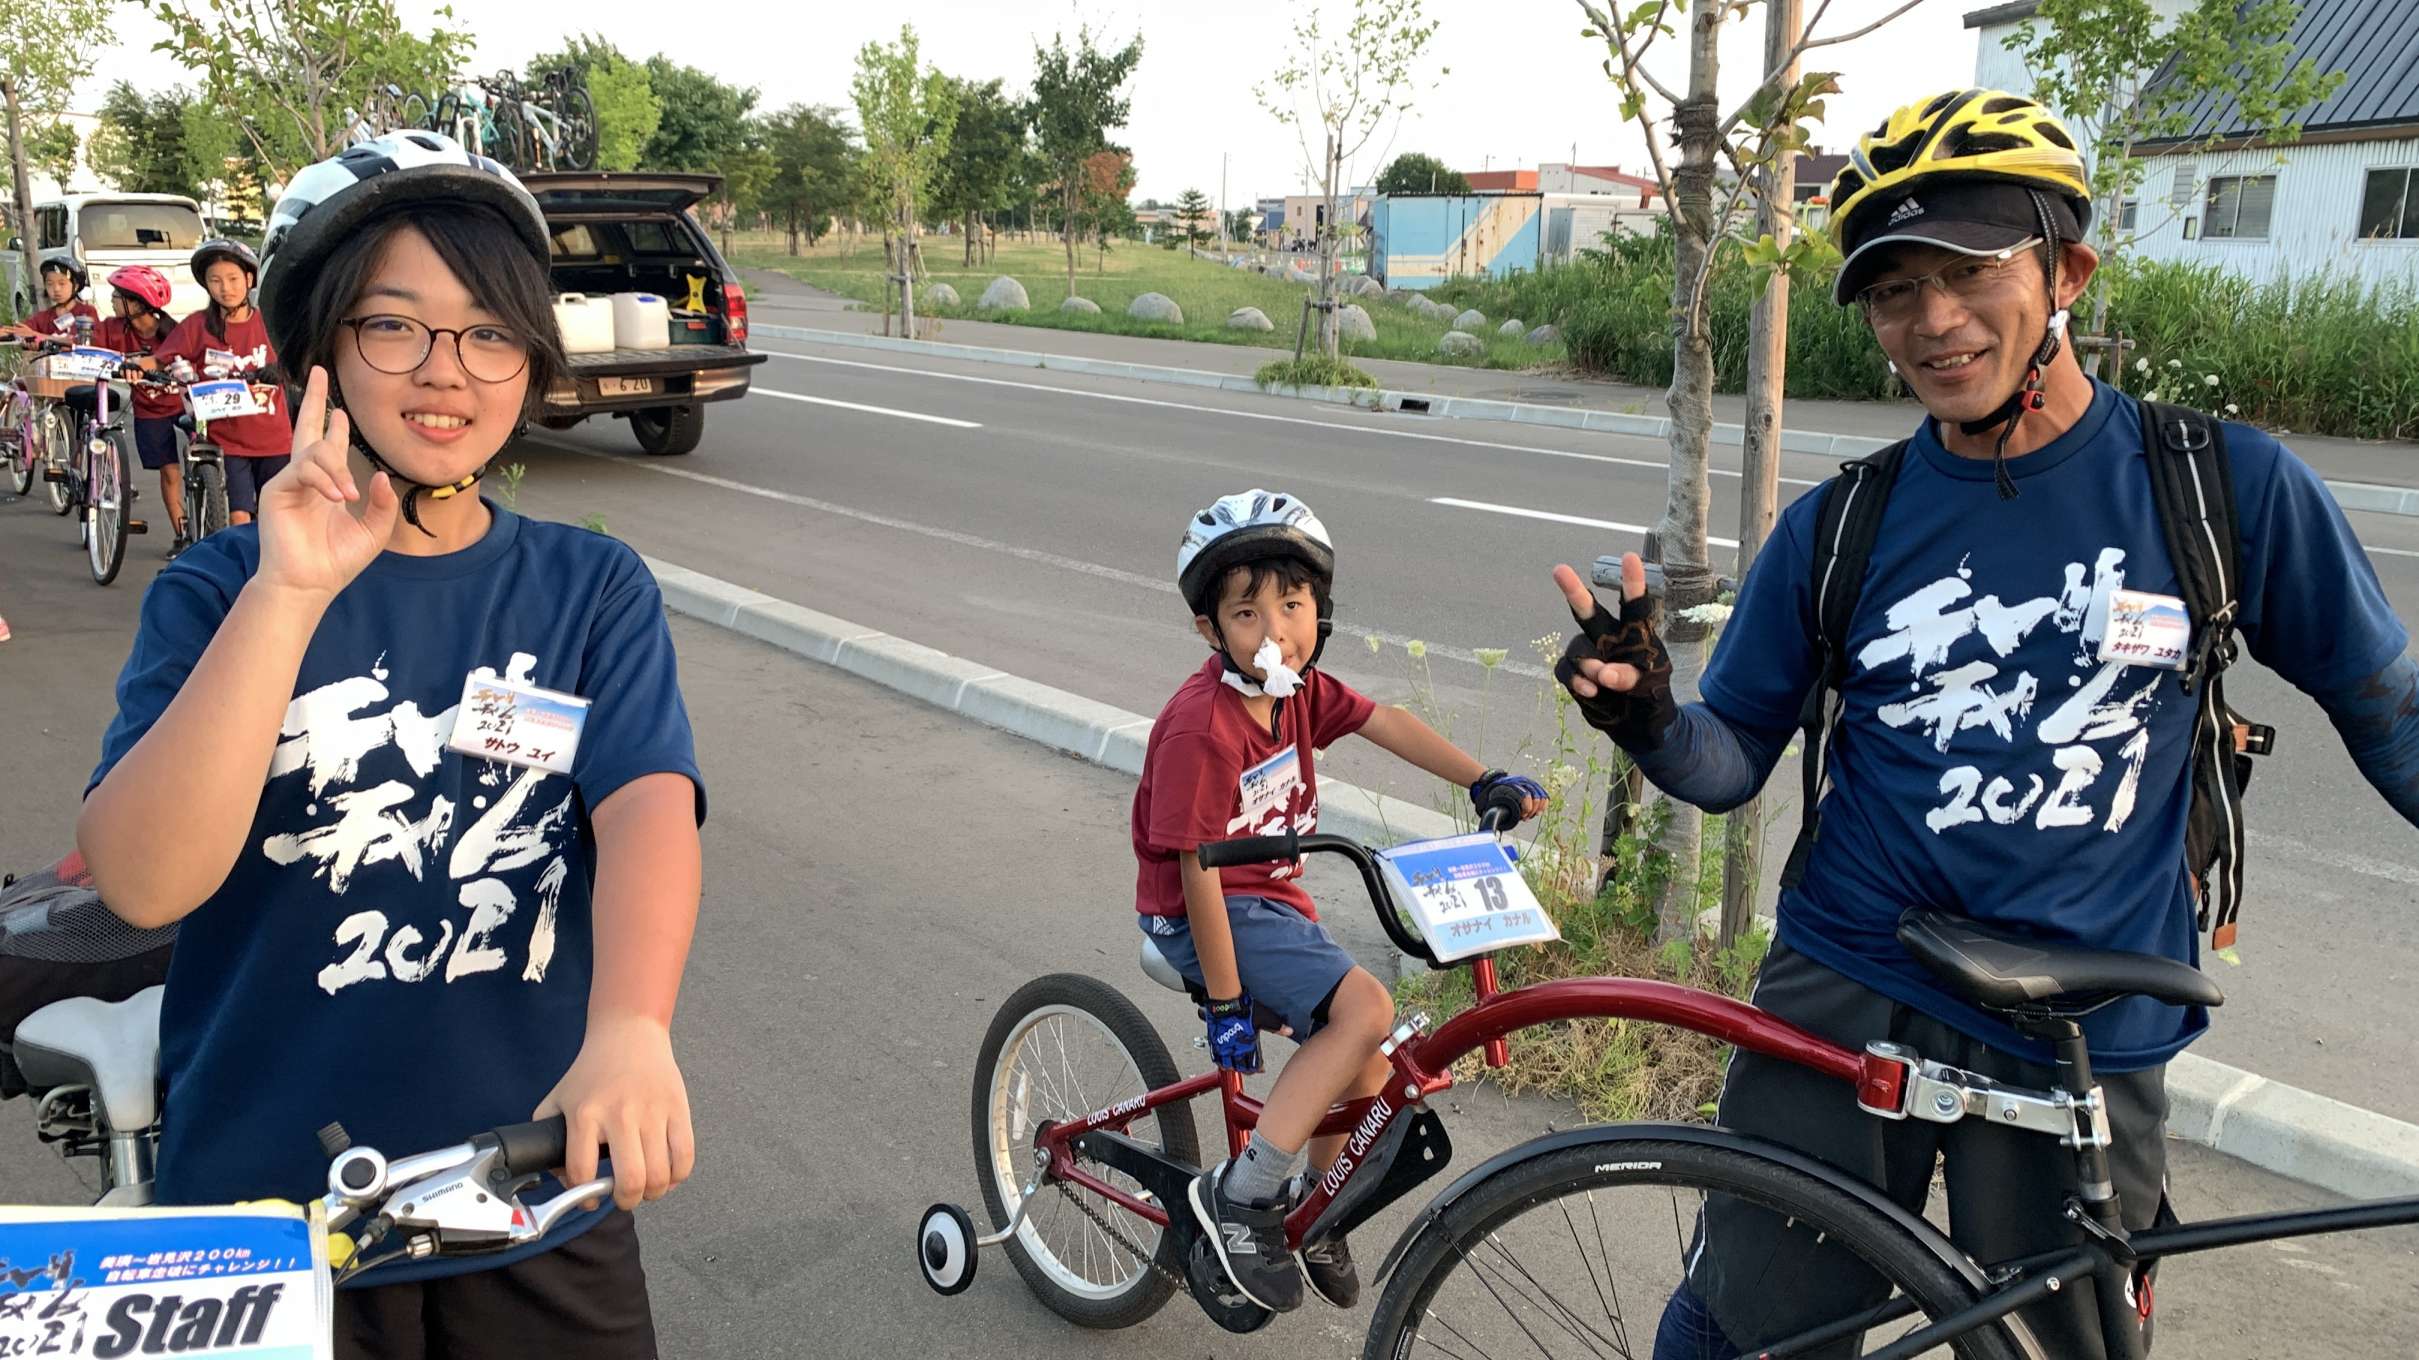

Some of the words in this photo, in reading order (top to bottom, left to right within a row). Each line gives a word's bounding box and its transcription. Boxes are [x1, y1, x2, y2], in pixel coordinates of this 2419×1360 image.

[1888, 207, 1925, 227] adidas
[224, 393, 241, 405] 29
[2112, 641, 2151, 655] タキザワ
[2153, 646, 2183, 660] ユタカ
[485, 736, 520, 754] サトウ
[526, 747, 556, 763] ユイ
[1926, 728, 2149, 834] 2021
[1473, 876, 1509, 912] 13
[318, 856, 568, 995] 2021
[1450, 918, 1492, 937] オサナイ
[1502, 912, 1532, 929] カナル
[1086, 1107, 1110, 1127] LOUIS
[1112, 1093, 1147, 1118] CANARU
[1322, 1152, 1352, 1198] LOUIS
[1348, 1096, 1393, 1158] CANARU
[1594, 1161, 1662, 1173] MERIDA
[422, 1182, 464, 1203] SHIMANO
[93, 1283, 284, 1360] Staff
